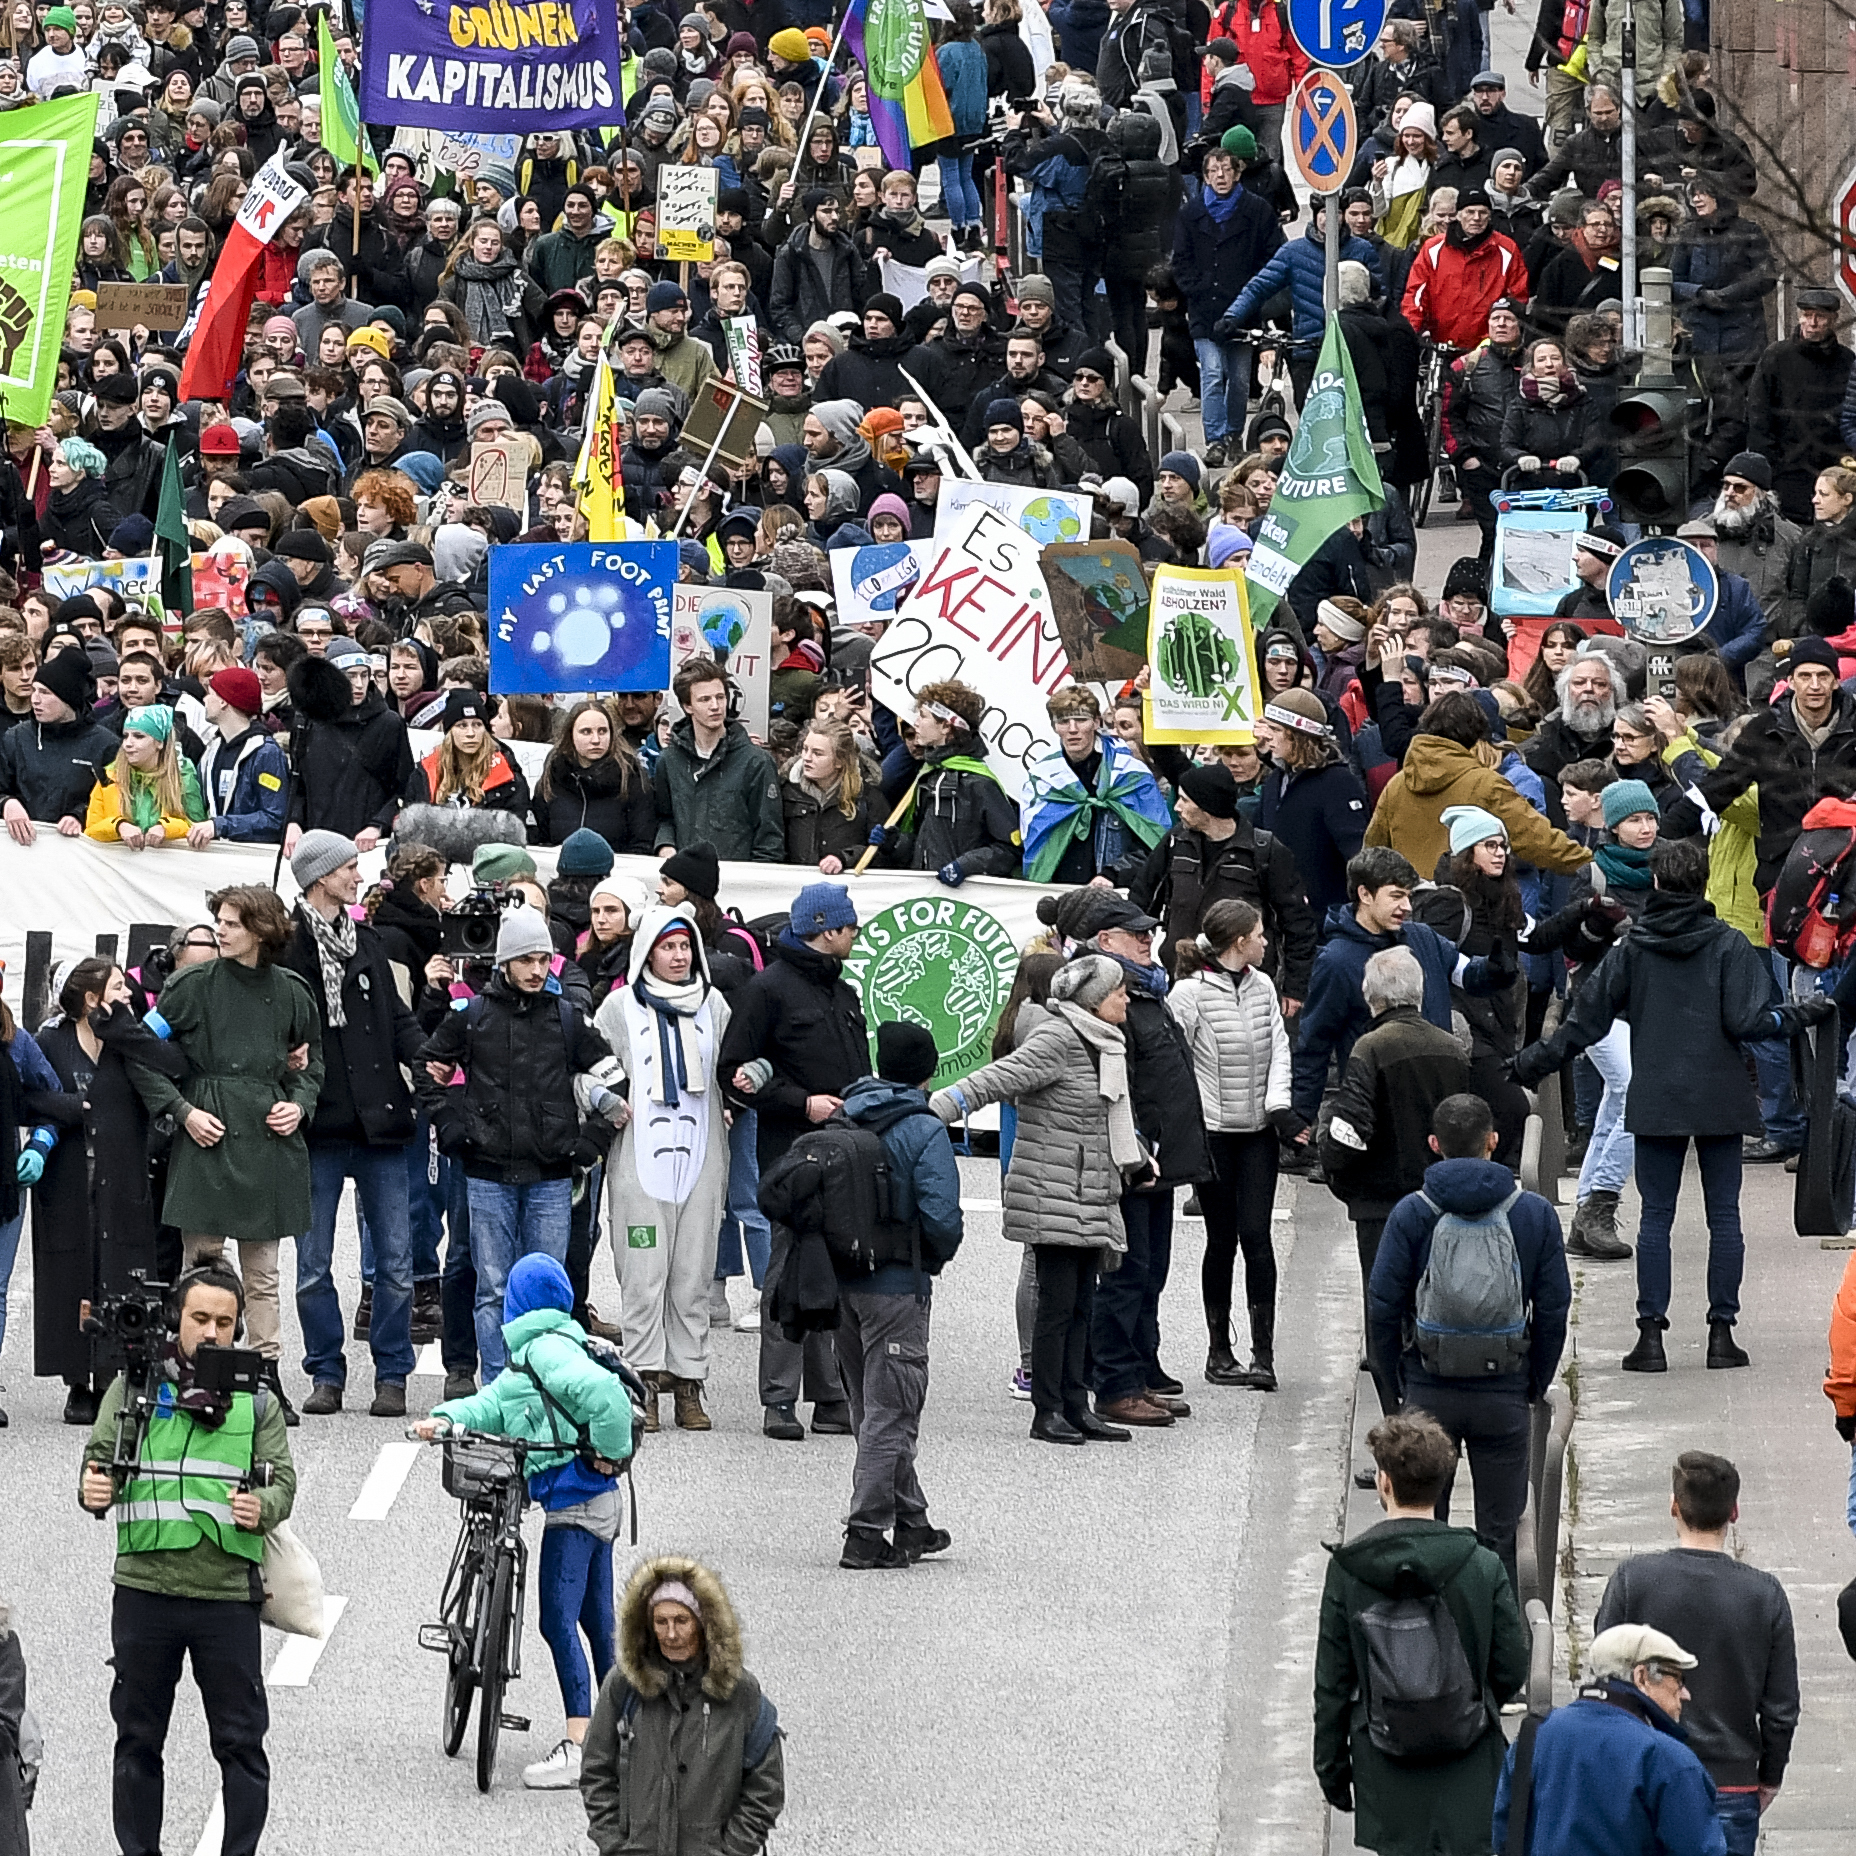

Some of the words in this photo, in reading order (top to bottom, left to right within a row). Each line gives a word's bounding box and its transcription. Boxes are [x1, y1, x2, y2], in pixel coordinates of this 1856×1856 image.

[386, 51, 614, 110] KAPITALISMUS
[1276, 472, 1349, 501] FUTURE
[961, 511, 1021, 572] ES
[894, 555, 918, 581] EGO
[497, 606, 518, 642] MY
[522, 554, 566, 596] LAST
[590, 550, 651, 588] FOOT
[647, 586, 671, 640] PRINT
[675, 595, 703, 614] DIE
[1159, 595, 1227, 610] ABHOLZEN?
[1198, 587, 1227, 597] Wald
[1158, 698, 1179, 709] DAS
[892, 898, 955, 933] FOR
